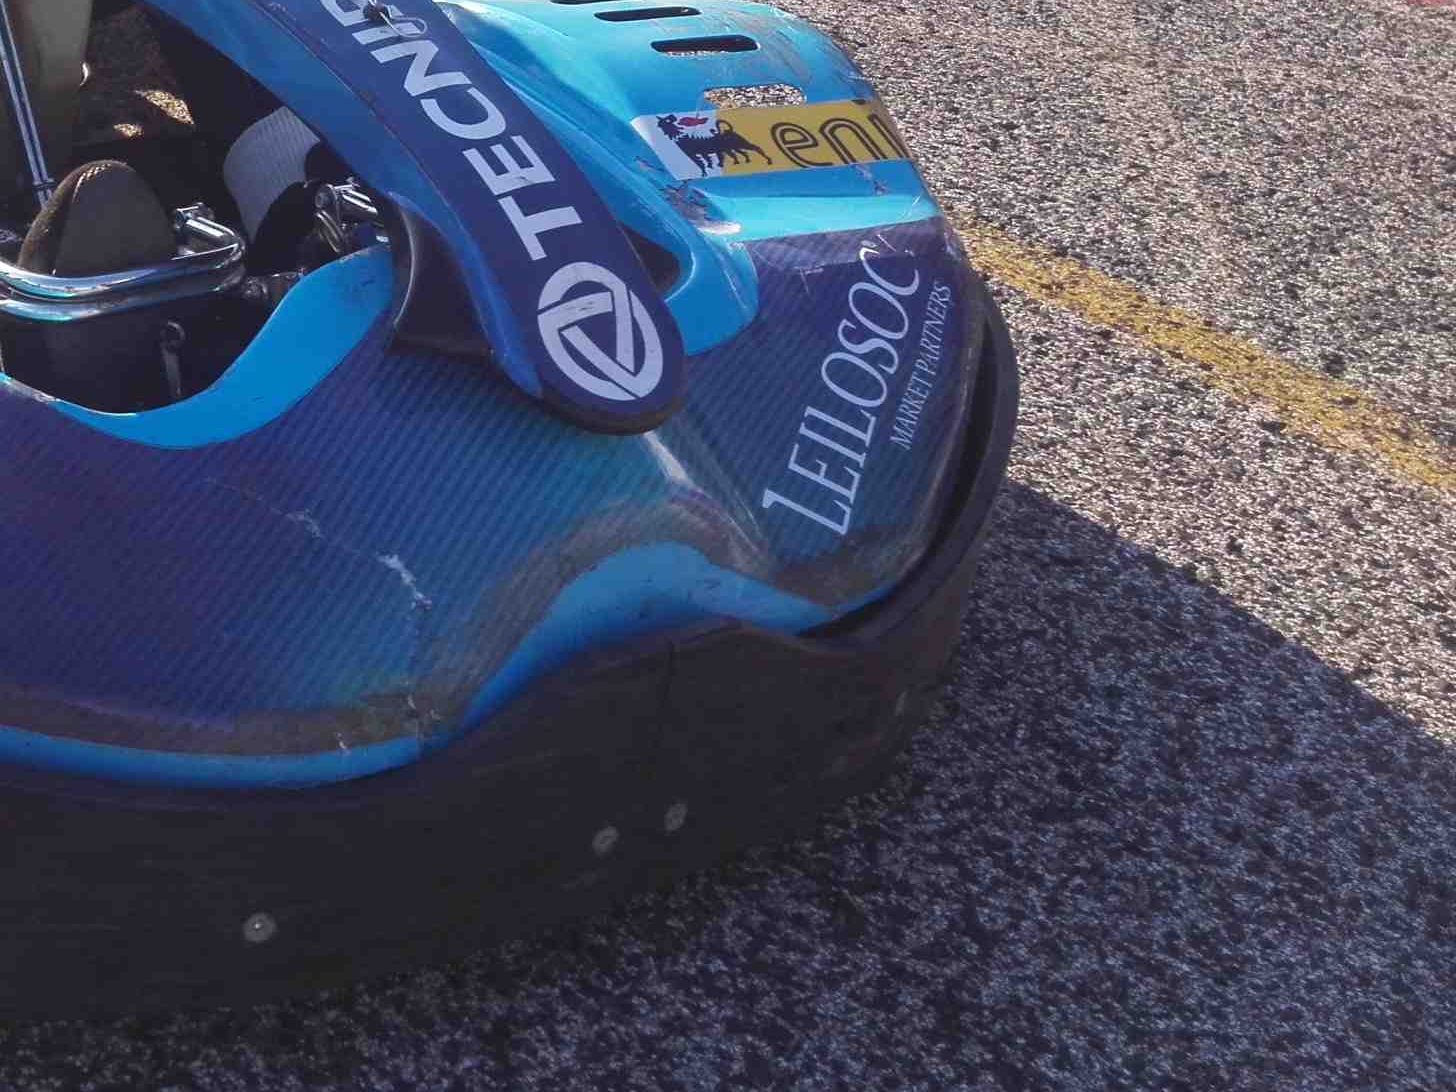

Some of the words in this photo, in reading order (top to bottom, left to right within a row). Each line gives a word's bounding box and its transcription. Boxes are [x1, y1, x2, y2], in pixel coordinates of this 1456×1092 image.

[770, 99, 911, 169] eni
[762, 243, 921, 536] LEILOSOC
[889, 368, 934, 452] MARKET
[918, 283, 954, 380] PARTNERS
